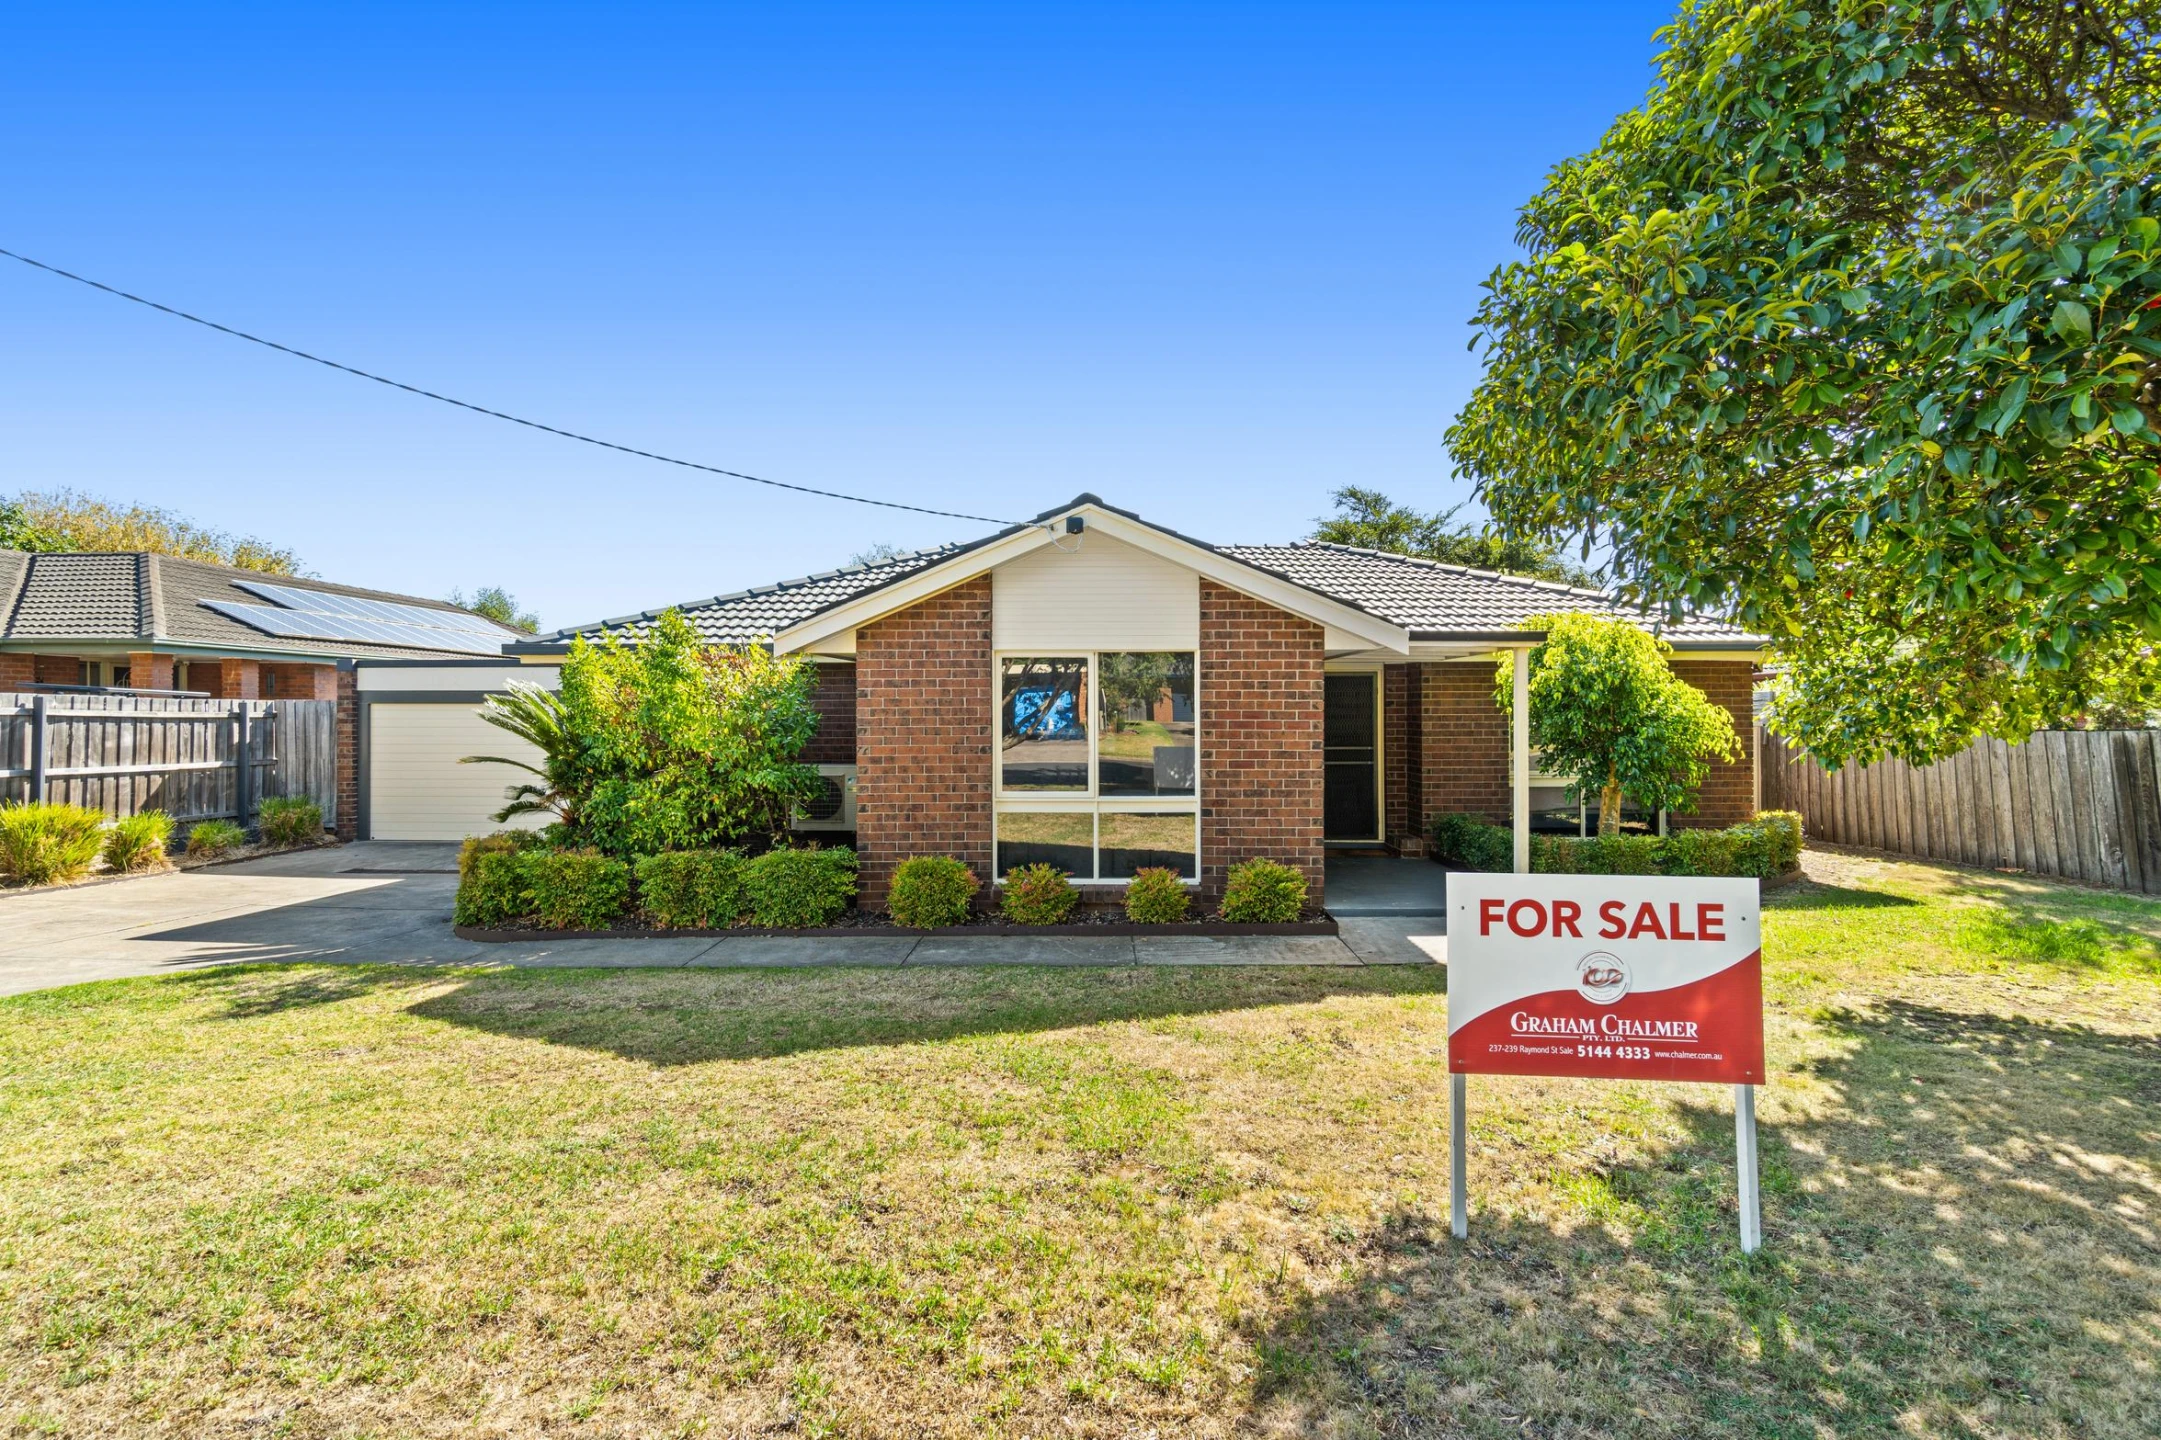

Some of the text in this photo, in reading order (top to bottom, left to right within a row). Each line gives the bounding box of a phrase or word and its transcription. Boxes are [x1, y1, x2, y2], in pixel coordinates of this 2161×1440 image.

[1480, 899, 1726, 941] FOR SALE
[1510, 1011, 1698, 1038] GRAHAM CHALMER
[1582, 1034, 1626, 1043] PTY. LTD.
[1488, 1044, 1723, 1061] 237-239 Raymond St Sale 5144 4333 www.chalmer.com.au
